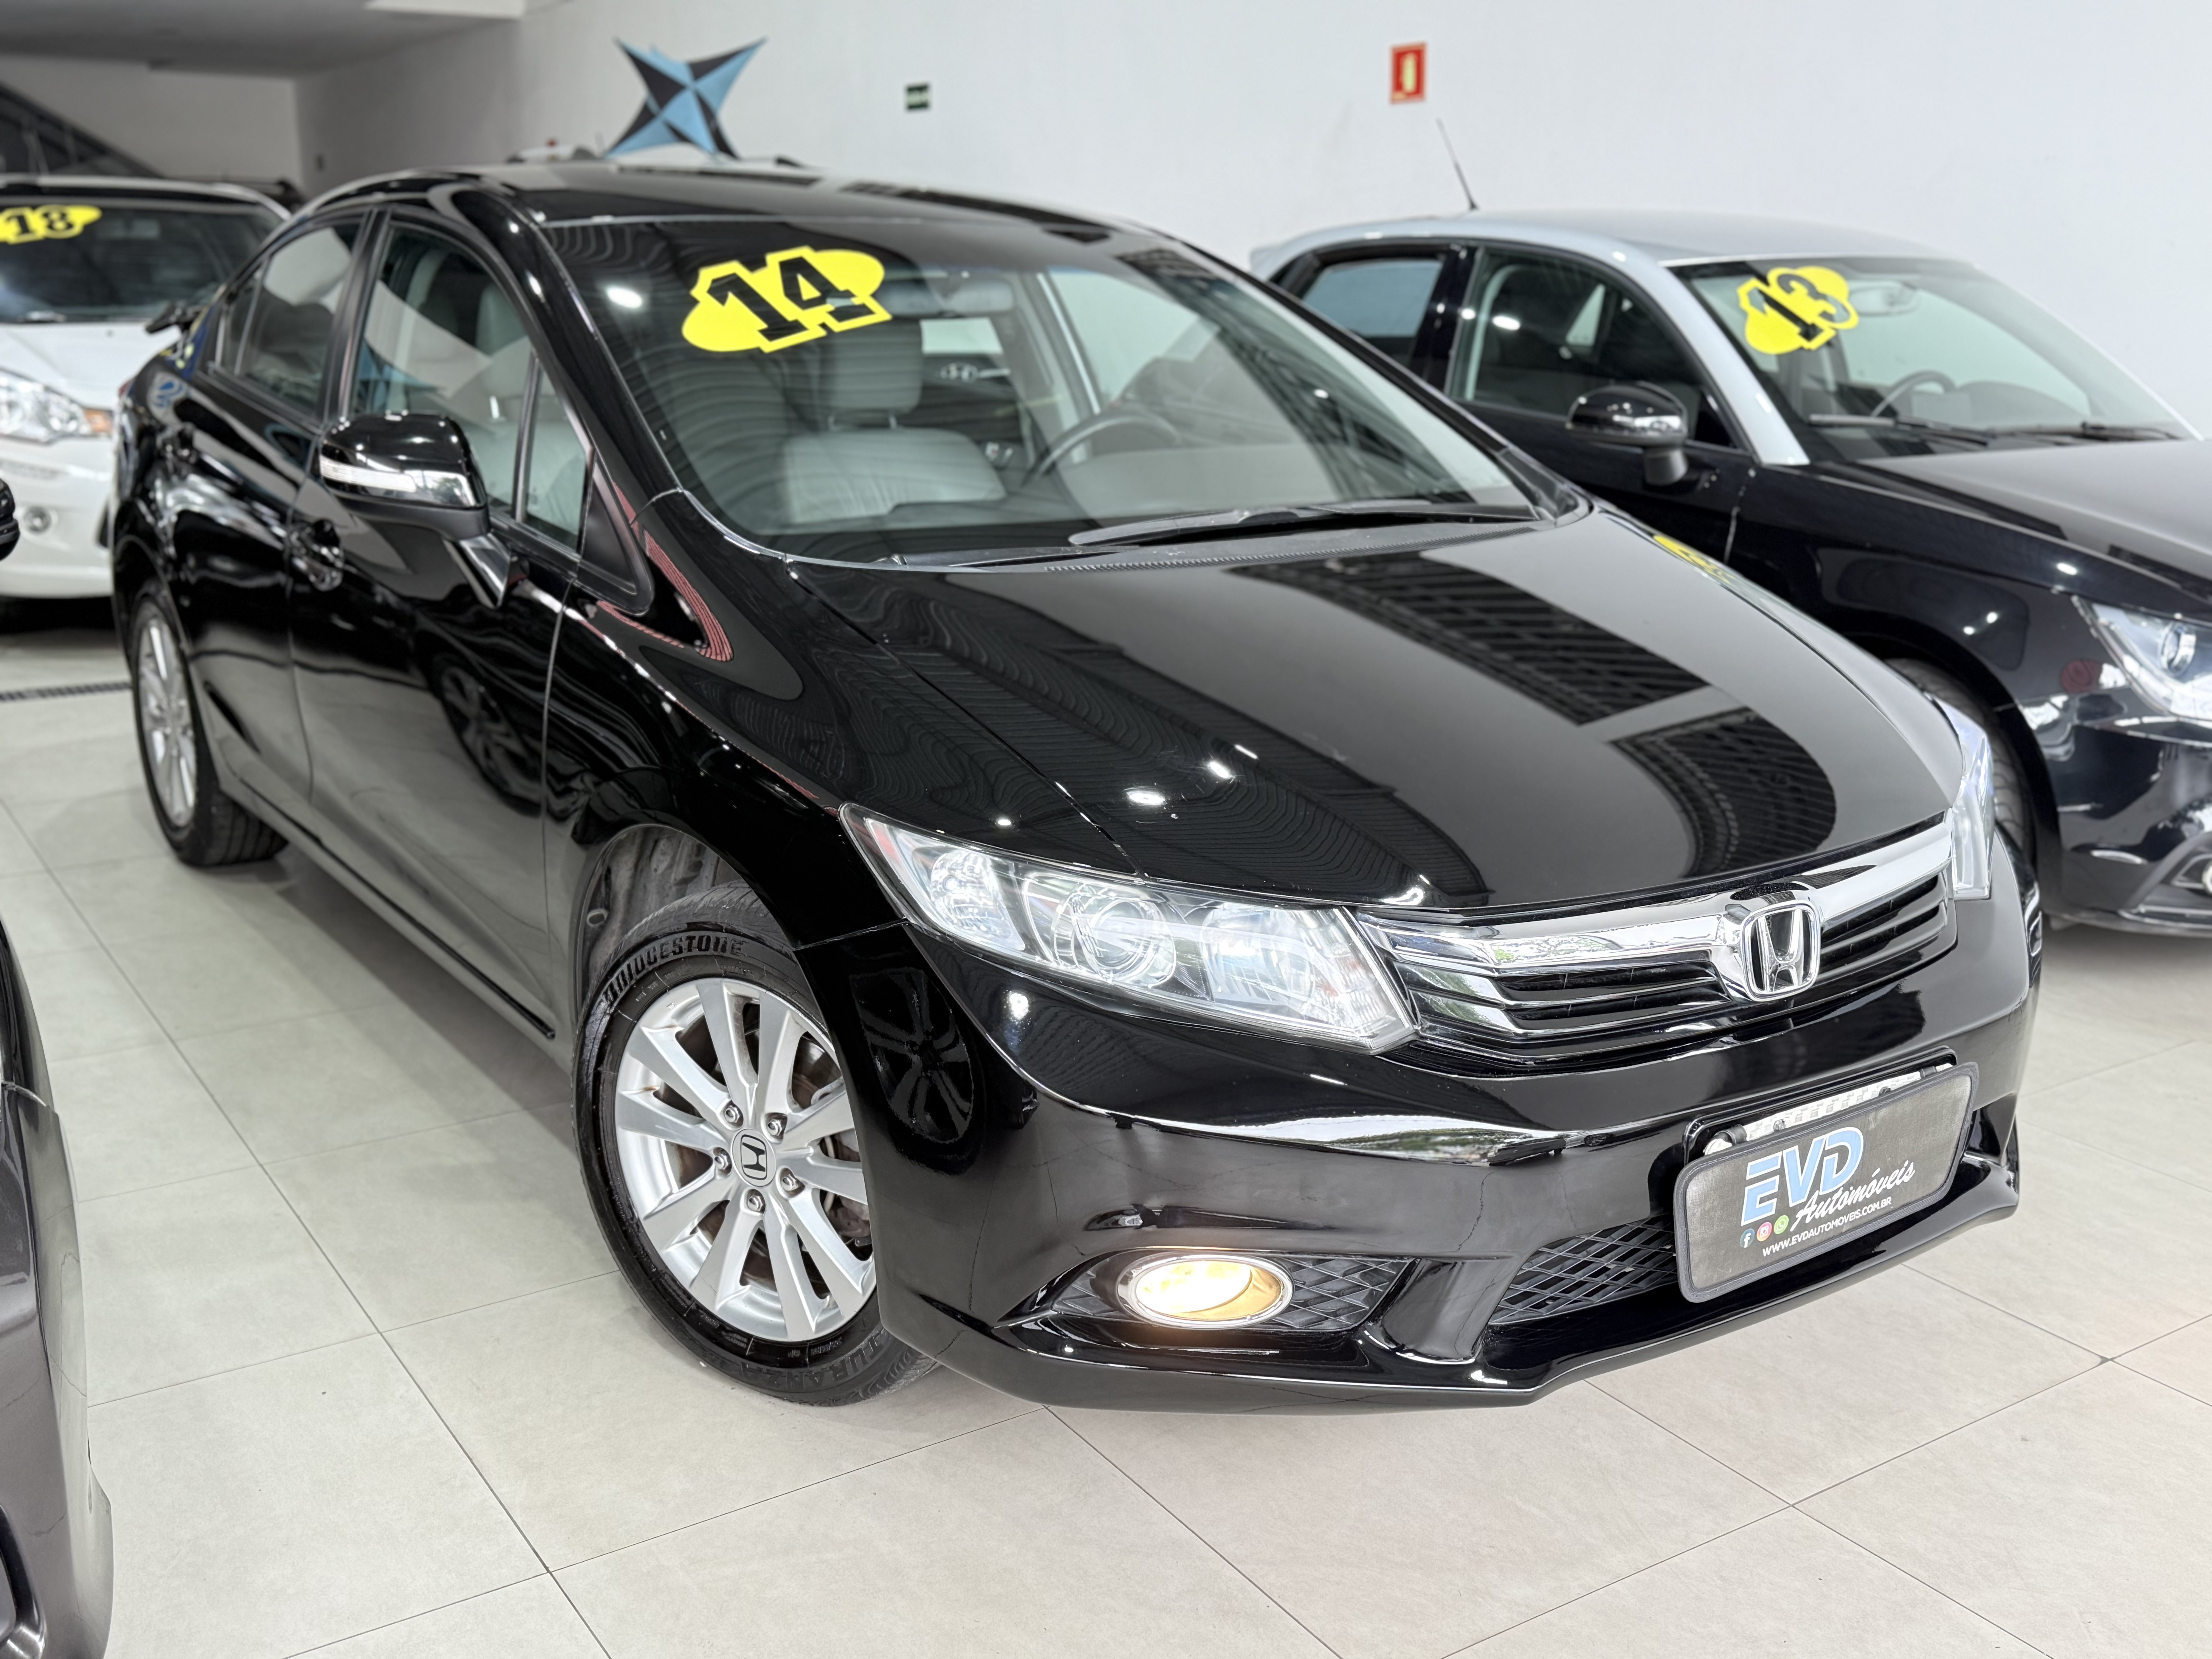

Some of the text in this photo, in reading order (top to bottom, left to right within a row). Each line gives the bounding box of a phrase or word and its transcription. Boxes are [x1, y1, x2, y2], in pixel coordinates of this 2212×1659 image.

[5, 210, 74, 234] 18
[706, 256, 877, 342] 14
[1746, 273, 1851, 342] 13
[601, 934, 745, 1003] BRIDGESTONE
[1741, 1127, 1864, 1226] EVD
[1790, 1159, 1916, 1232] Automóveis
[1762, 1196, 1892, 1257] WWW.EVDAUTOMOVEIS.COM.BR
